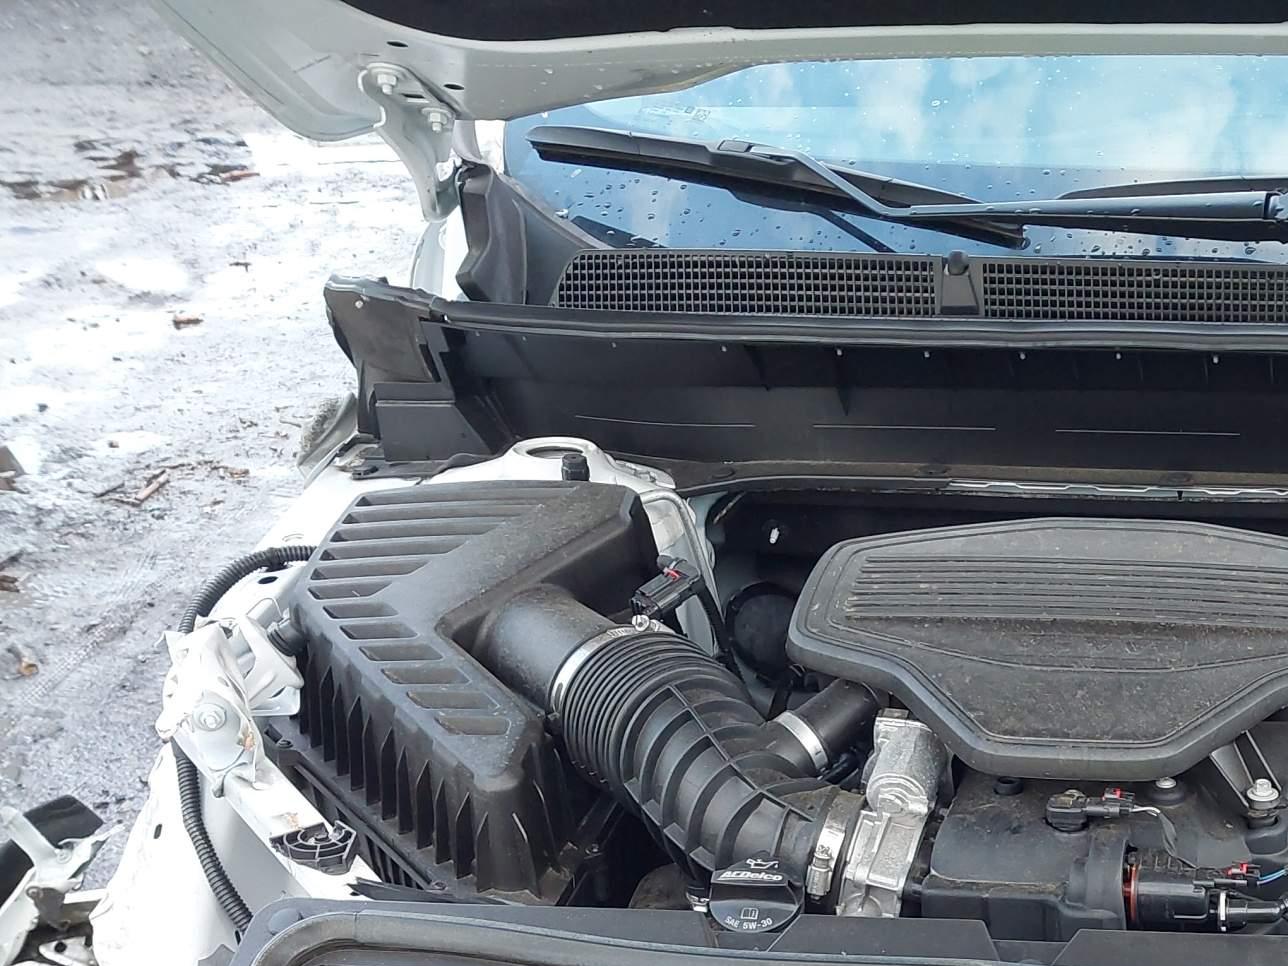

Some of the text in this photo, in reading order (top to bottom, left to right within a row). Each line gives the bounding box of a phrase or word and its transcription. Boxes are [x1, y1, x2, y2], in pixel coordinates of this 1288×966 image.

[719, 870, 783, 881] ACDelco
[724, 915, 773, 930] SAE 5W-30
